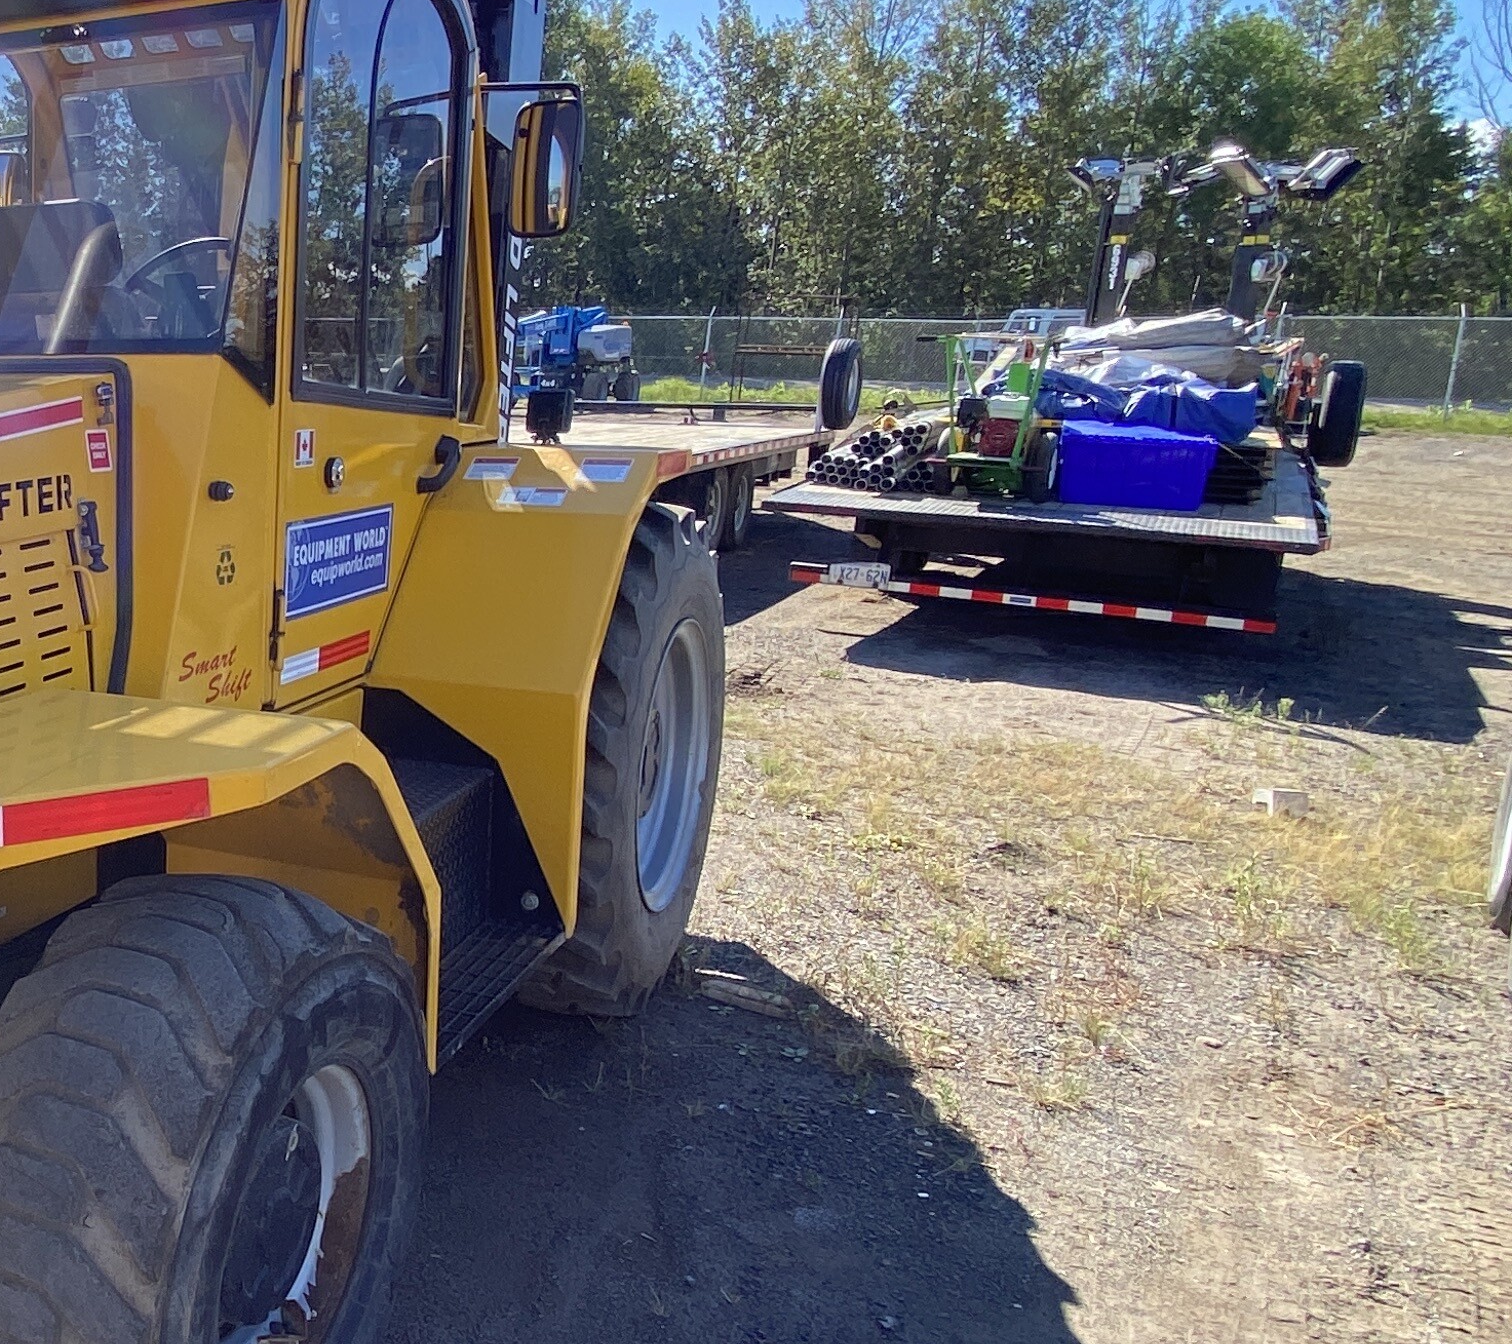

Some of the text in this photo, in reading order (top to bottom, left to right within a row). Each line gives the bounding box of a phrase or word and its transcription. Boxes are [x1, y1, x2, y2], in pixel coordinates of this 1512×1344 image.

[293, 525, 387, 566] EQUIPMENT WORLD
[311, 551, 384, 587] equipworld.com
[179, 645, 238, 681] Smart
[205, 668, 252, 704] Shift
